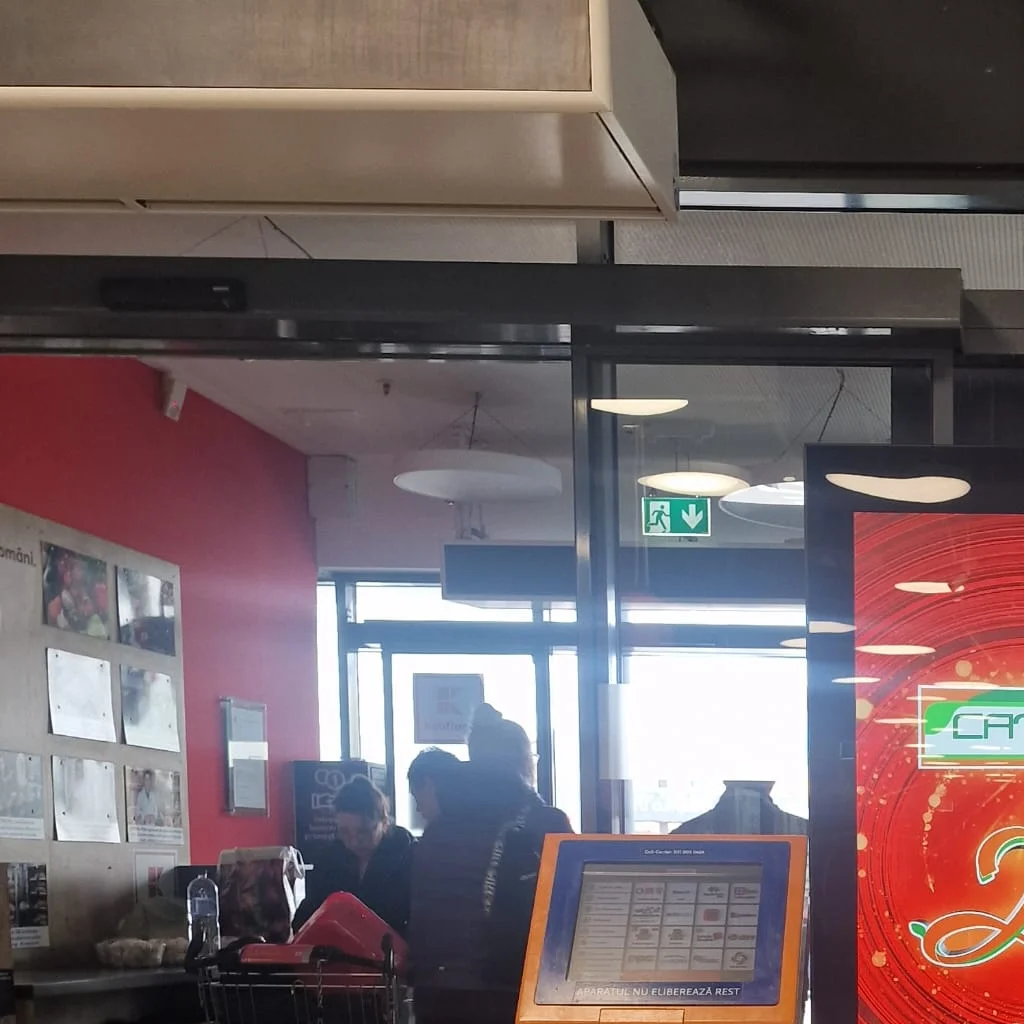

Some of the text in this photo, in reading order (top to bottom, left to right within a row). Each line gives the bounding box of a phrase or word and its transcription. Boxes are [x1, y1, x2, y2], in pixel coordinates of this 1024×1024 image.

[632, 987, 648, 996] NU
[651, 986, 712, 996] ELIBEREAZĂ
[715, 987, 741, 996] REST
